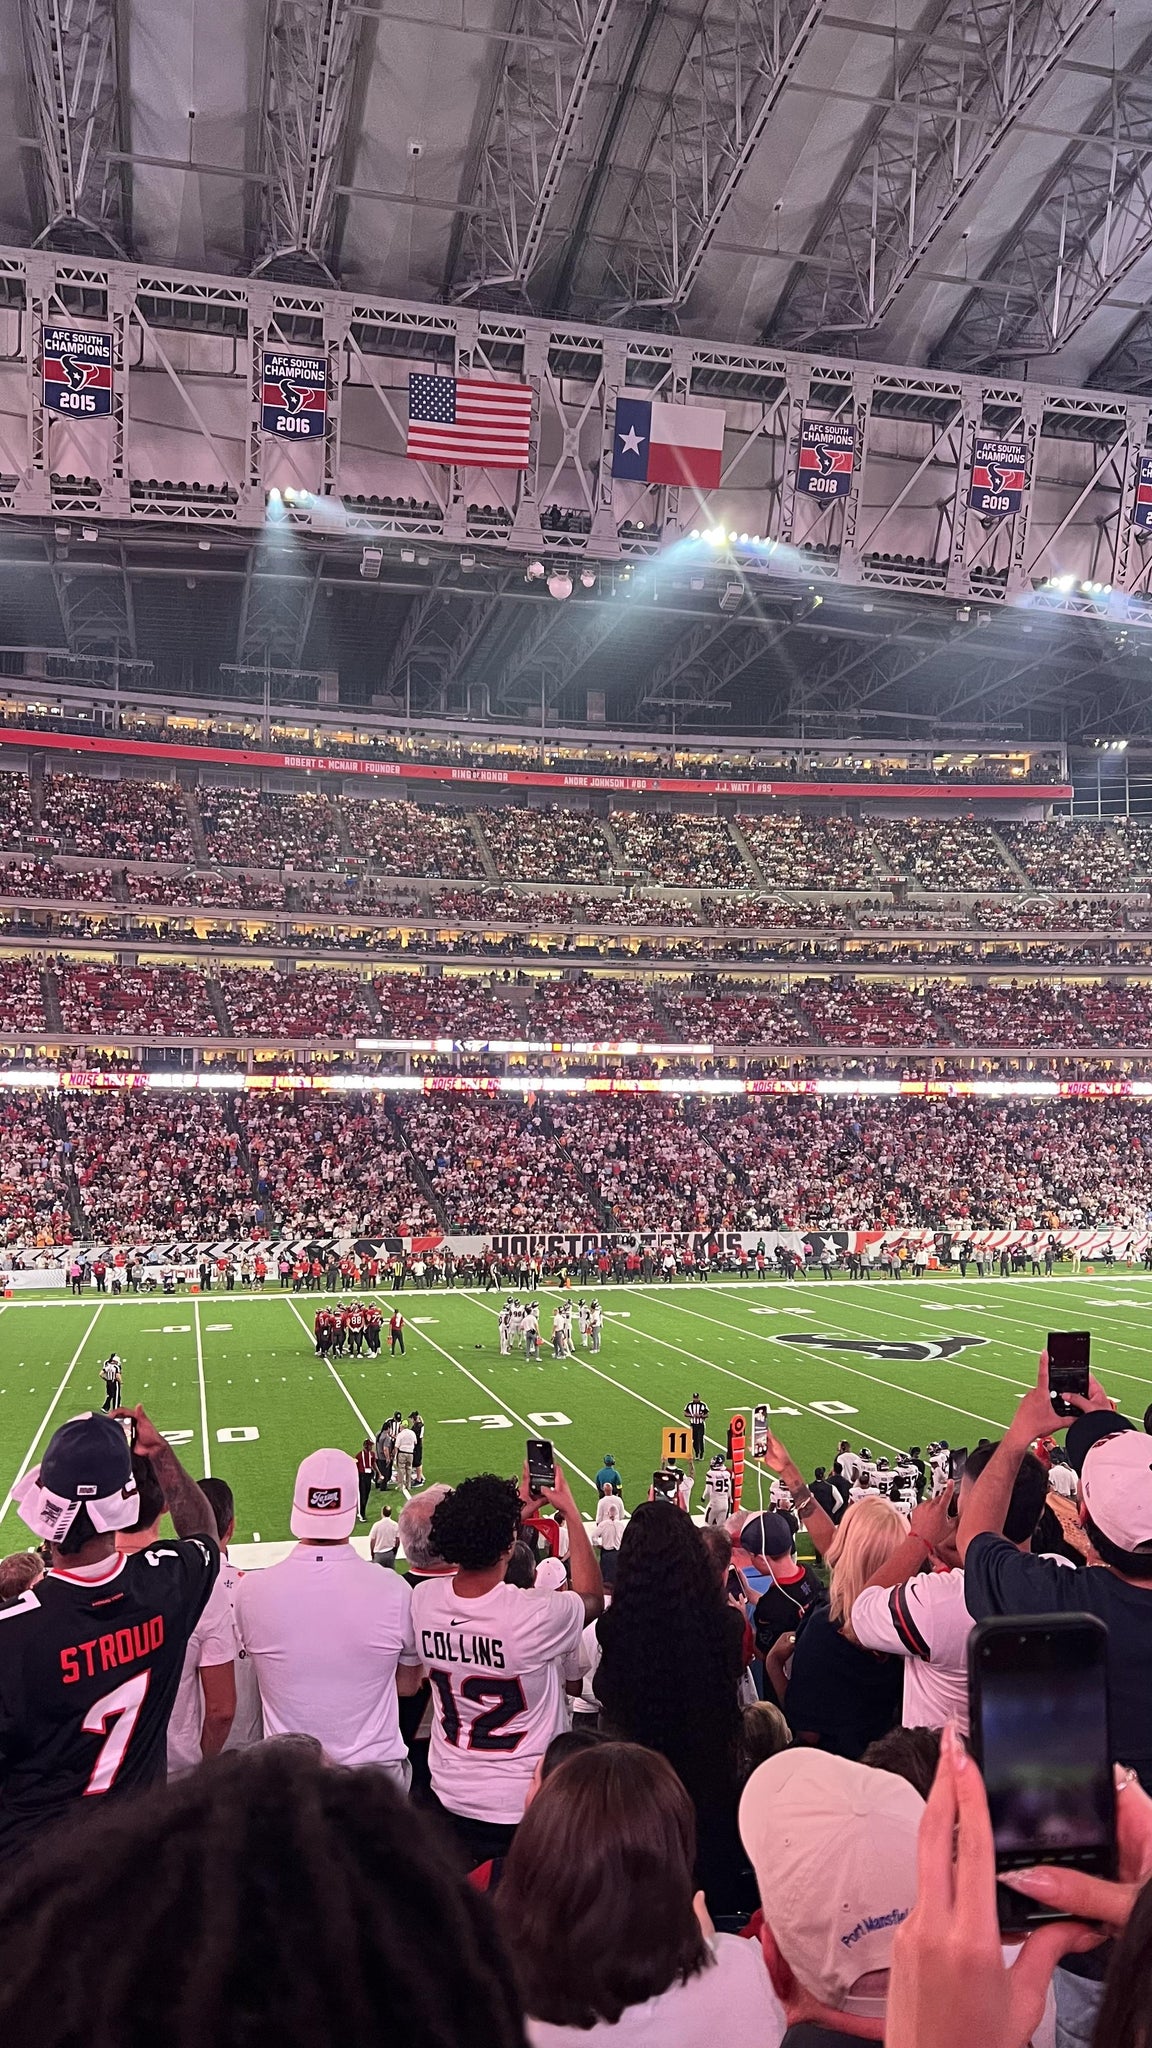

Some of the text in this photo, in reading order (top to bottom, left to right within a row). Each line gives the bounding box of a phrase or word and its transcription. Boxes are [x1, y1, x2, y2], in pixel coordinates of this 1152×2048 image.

[51, 330, 103, 346] AFC SOUTH
[44, 339, 110, 358] CHAMPIONS
[271, 356, 319, 370] AFC SOUTH
[264, 364, 325, 382] CHAMPIONS
[59, 392, 96, 412] 2015
[276, 415, 310, 434] 2016
[808, 424, 849, 436] AFC SOUTH
[802, 431, 854, 446] CHAMPIONS
[976, 449, 1026, 464] CHAMPIONS
[982, 442, 1021, 455] AFC SOUTH
[808, 477, 837, 494] 2018
[981, 494, 1010, 511] 2019
[284, 756, 401, 774] ROBERT C. MCNAIR FOUNDER
[451, 769, 471, 779] RING
[481, 771, 509, 781] HONOR
[563, 776, 588, 786] ANDRE
[590, 777, 625, 788] JOHNSON
[731, 783, 750, 792] WATT
[757, 784, 772, 793] #99
[492, 1235, 617, 1258] HOUSTON
[351, 1316, 362, 1324] 88
[668, 1432, 687, 1453] 11
[715, 1478, 729, 1493] 95
[60, 1615, 163, 1683] STROUD
[422, 1630, 505, 1669] COLLINS
[429, 1668, 528, 1753] 12
[81, 1667, 151, 1796] 7
[841, 1923, 866, 1948] Port
